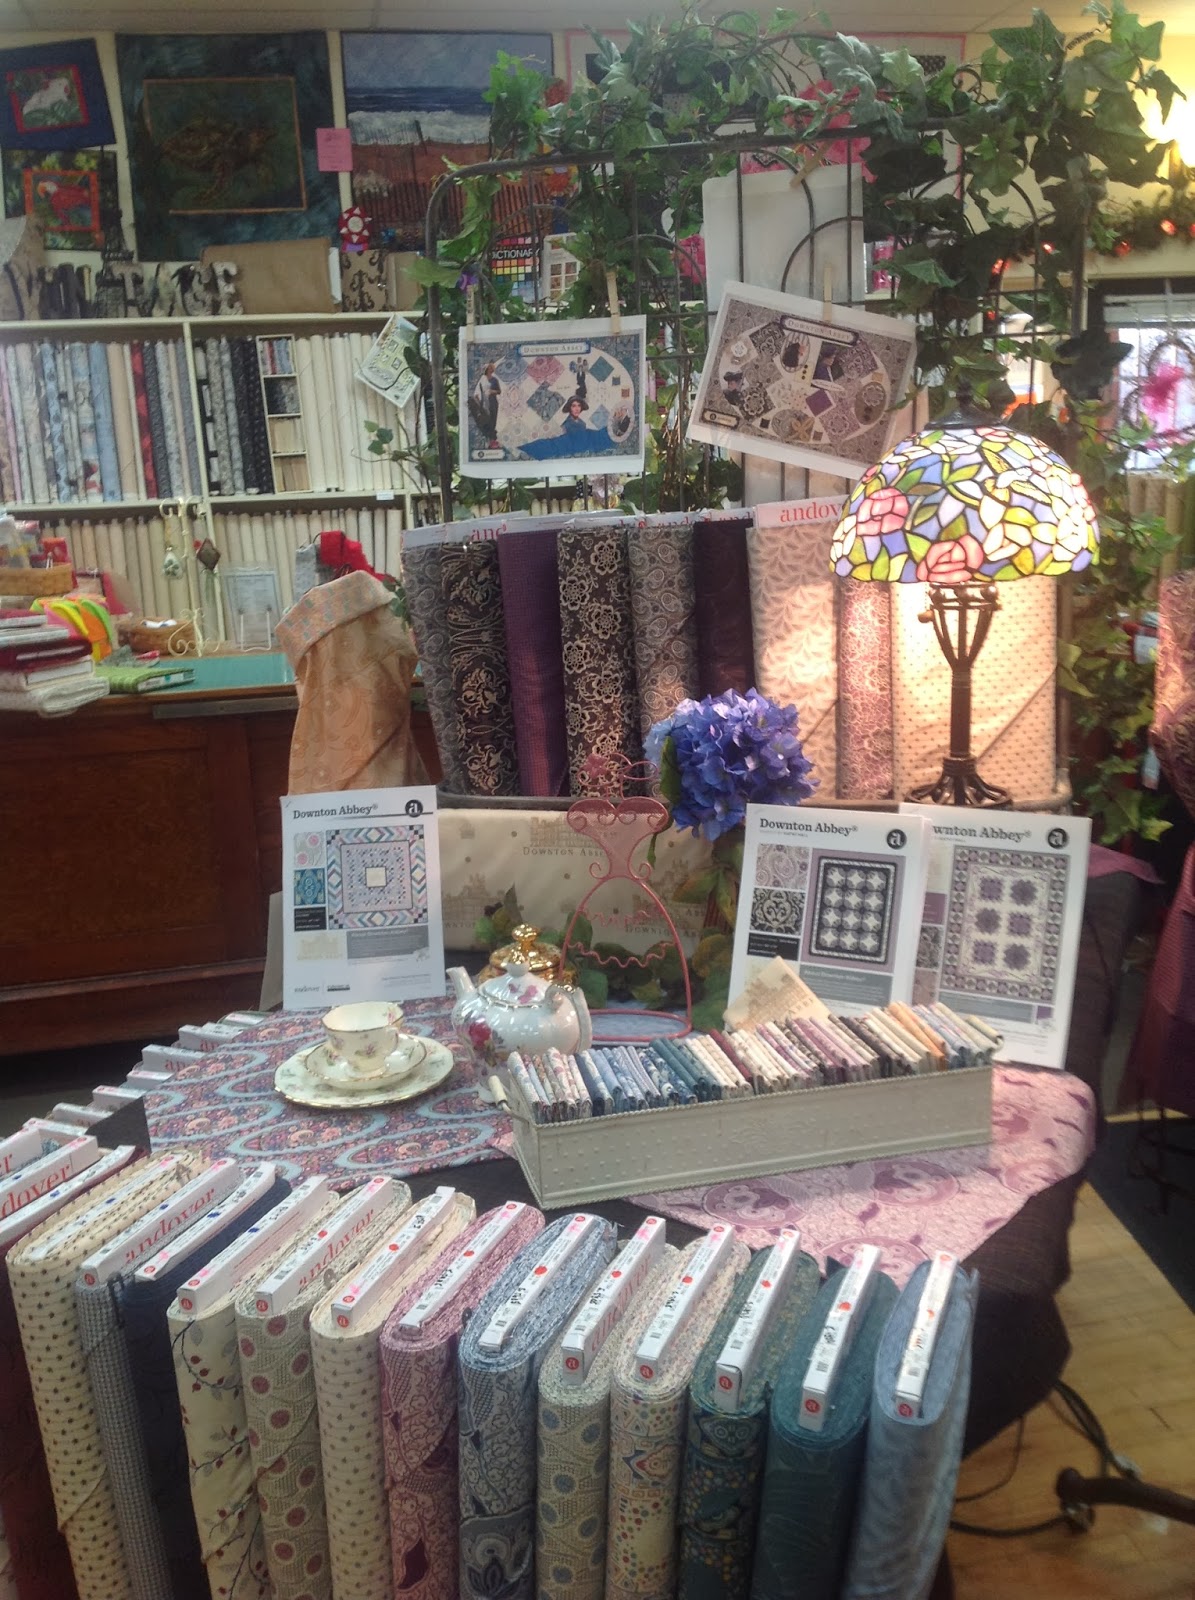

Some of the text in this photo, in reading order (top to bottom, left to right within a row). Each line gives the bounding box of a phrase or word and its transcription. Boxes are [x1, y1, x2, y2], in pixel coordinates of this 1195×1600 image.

[780, 502, 843, 523] andov
[293, 807, 337, 819] Downton
[760, 819, 813, 832] Downton
[932, 825, 977, 838] wnton
[1, 1164, 70, 1219] dover
